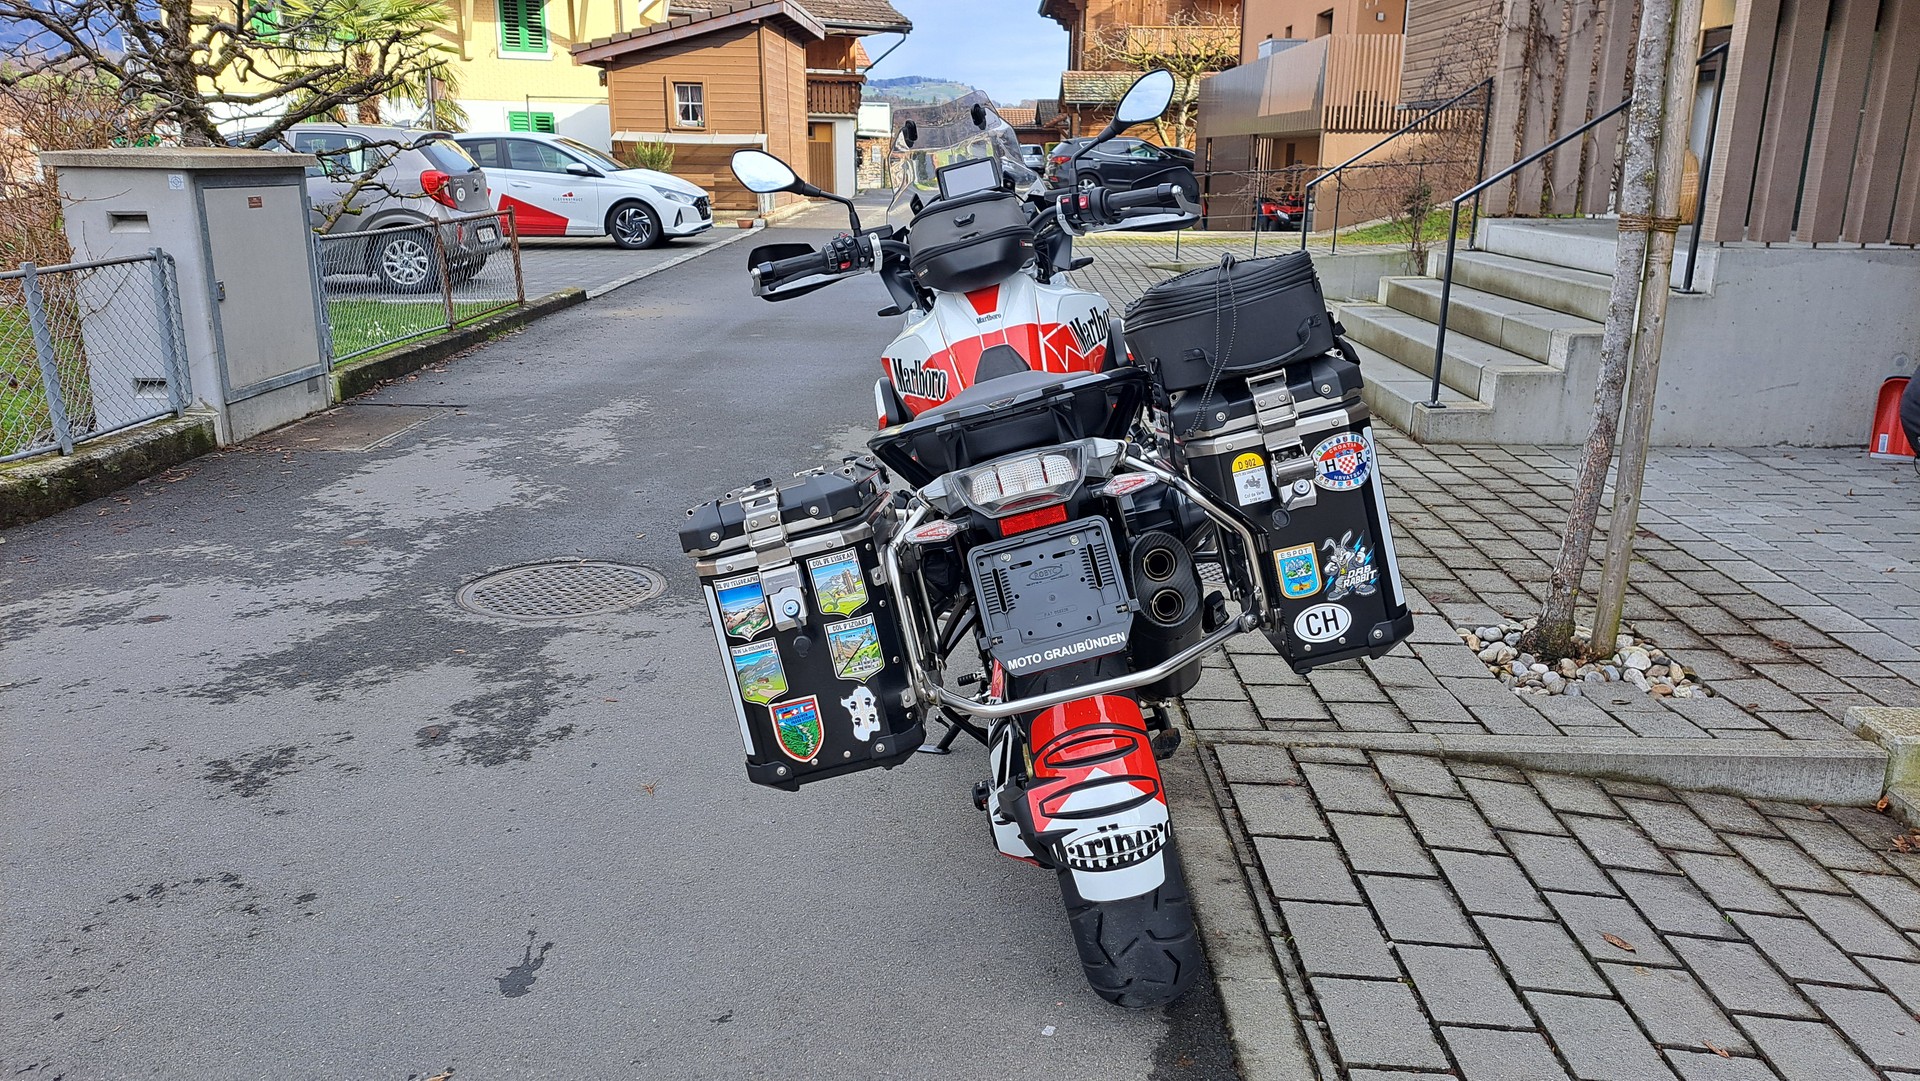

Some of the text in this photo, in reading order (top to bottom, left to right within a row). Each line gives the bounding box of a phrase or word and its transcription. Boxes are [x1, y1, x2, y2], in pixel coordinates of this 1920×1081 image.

[976, 313, 1002, 325] Marlboro
[1069, 306, 1111, 354] Marlbo
[892, 358, 948, 400] Marlboro
[1238, 458, 1257, 470] D 902
[1325, 458, 1337, 473] H
[1280, 547, 1309, 558] ESPOT
[1343, 569, 1377, 588] RABBIT
[1305, 608, 1340, 637] CH
[1007, 631, 1126, 670] MOTO GRAUBÜNDEN
